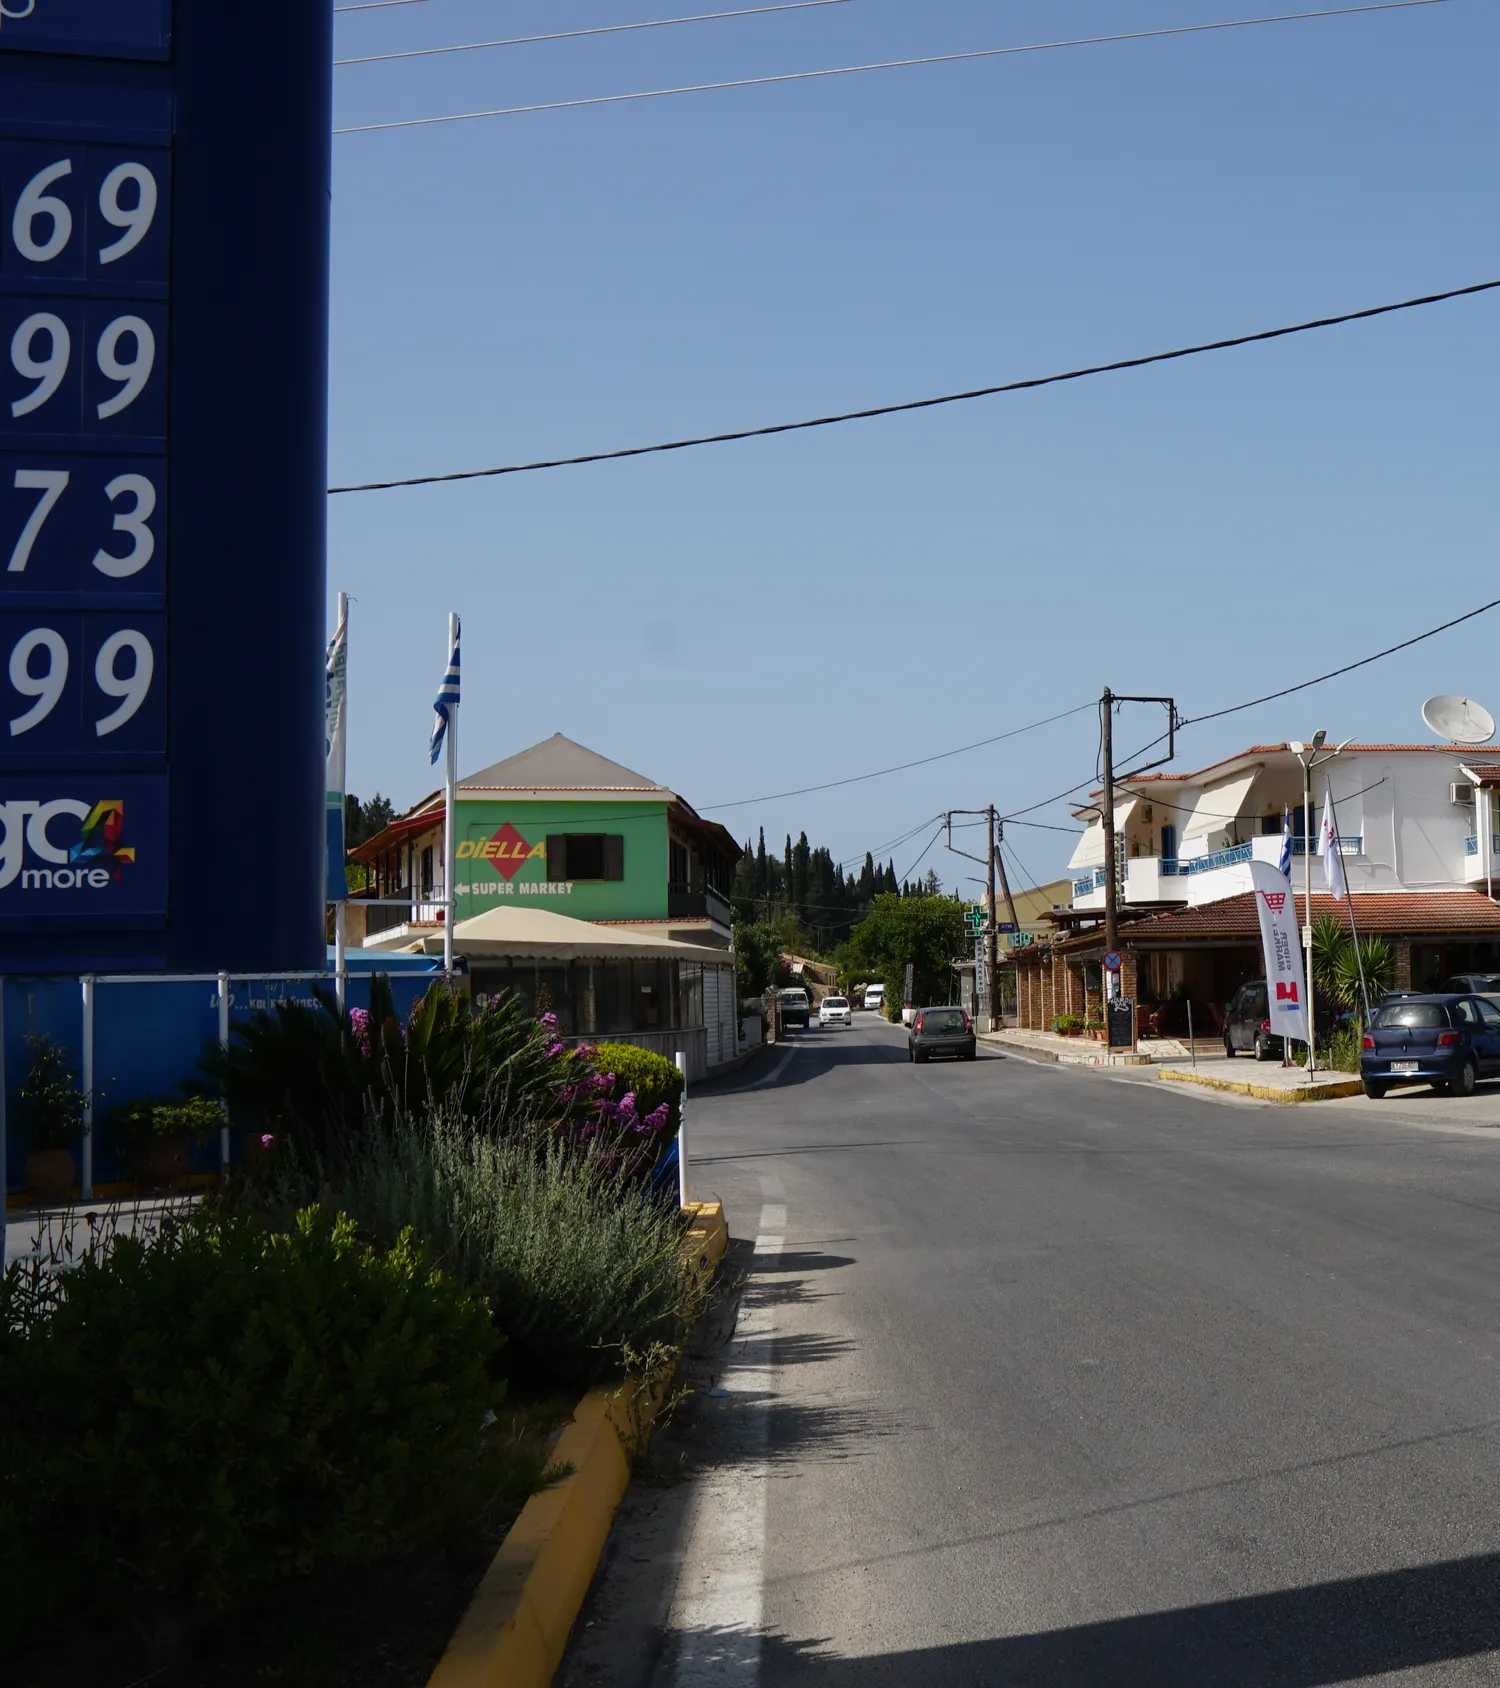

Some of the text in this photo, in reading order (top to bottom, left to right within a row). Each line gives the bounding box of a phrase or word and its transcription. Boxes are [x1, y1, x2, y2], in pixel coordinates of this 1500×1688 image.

[22, 869, 109, 888] more
[472, 883, 573, 894] SUPER MARKET
